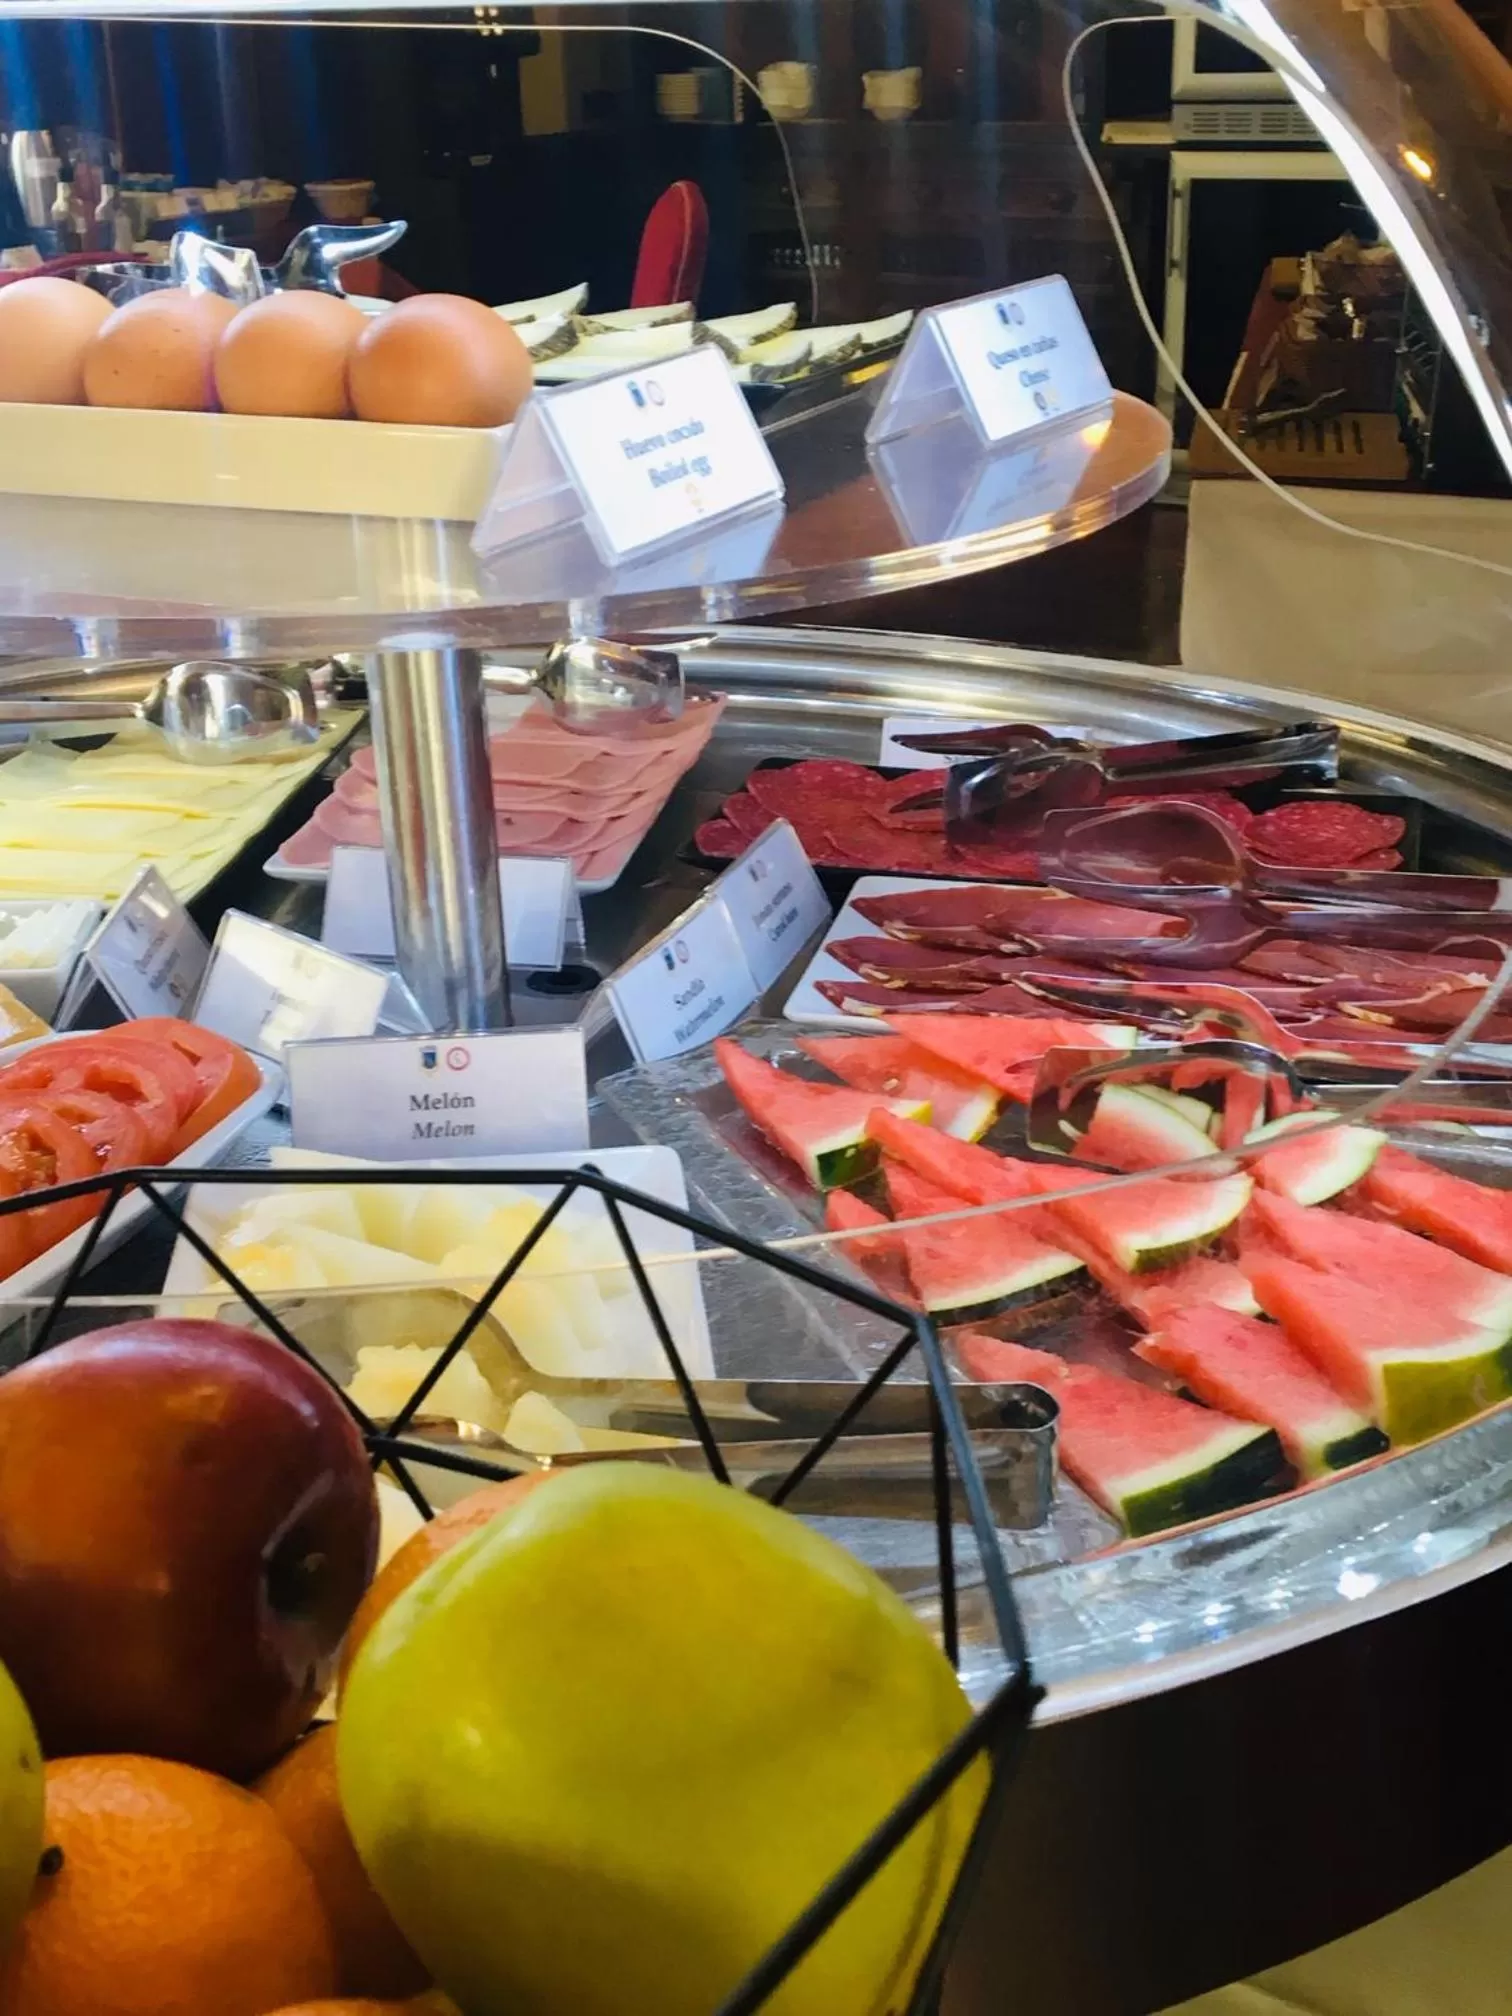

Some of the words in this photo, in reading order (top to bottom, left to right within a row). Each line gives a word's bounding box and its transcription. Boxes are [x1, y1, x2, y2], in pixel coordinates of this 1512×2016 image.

[619, 436, 666, 460] Huevo
[647, 457, 690, 488] Boiled
[690, 455, 713, 477] egg
[408, 1091, 477, 1112] Melón
[411, 1119, 476, 1140] Melon
